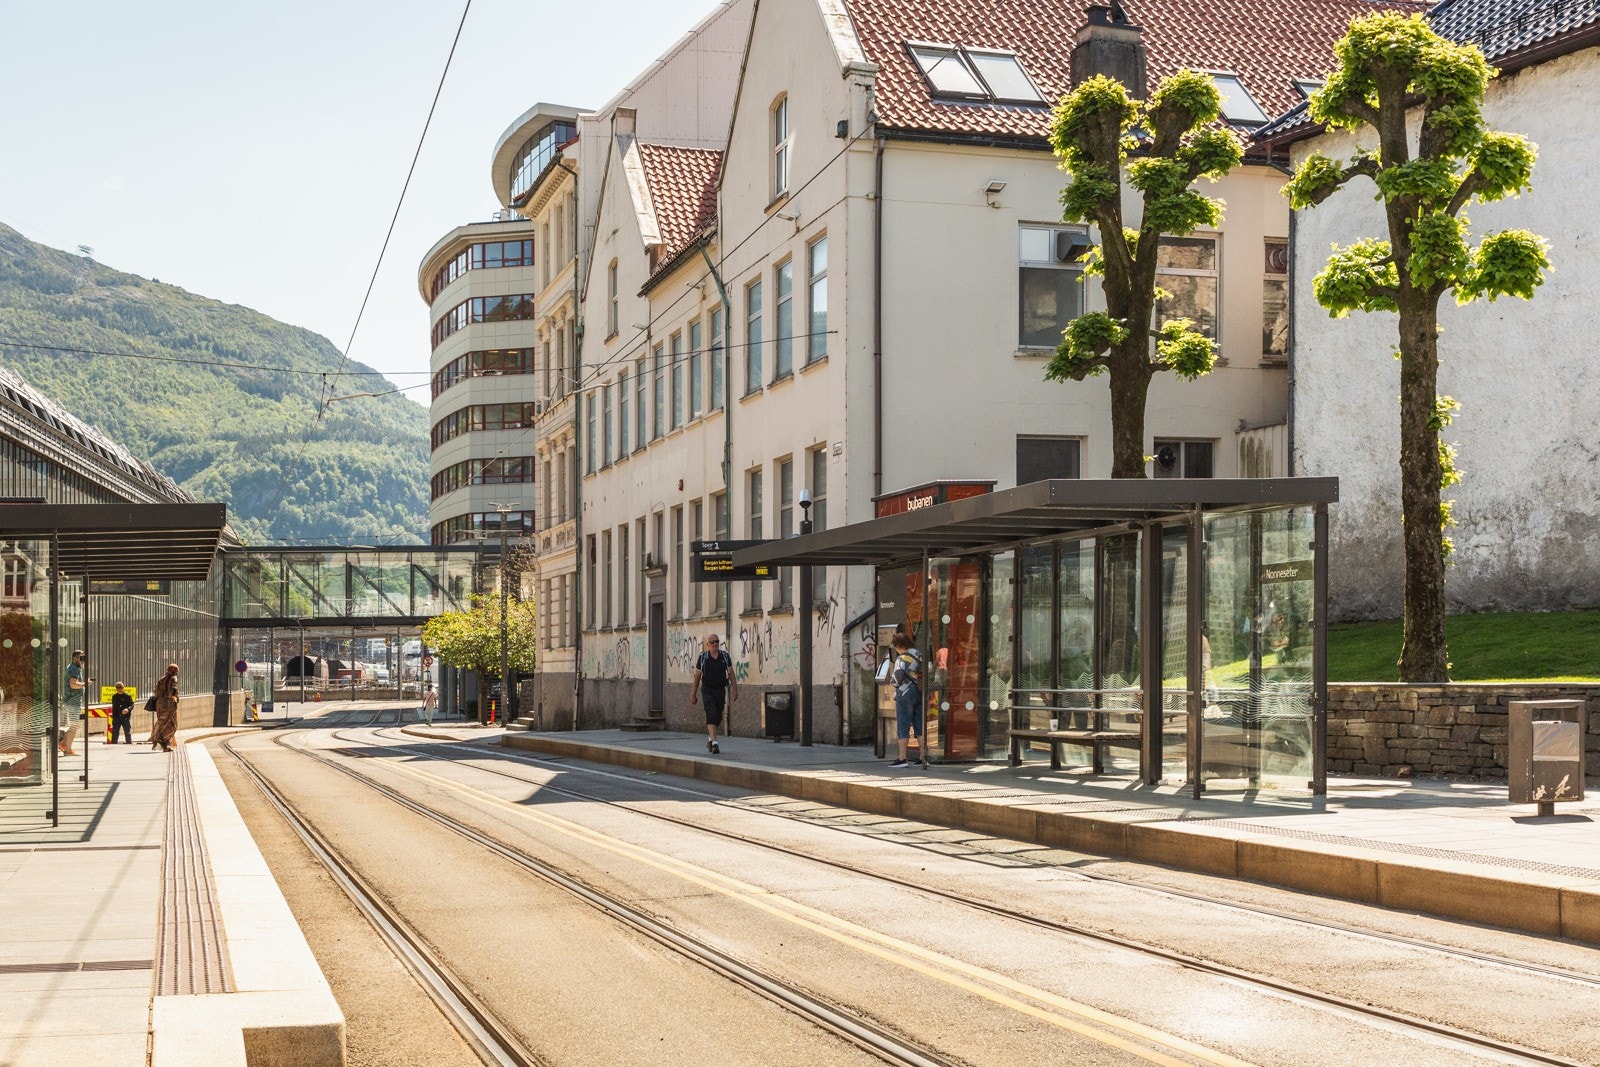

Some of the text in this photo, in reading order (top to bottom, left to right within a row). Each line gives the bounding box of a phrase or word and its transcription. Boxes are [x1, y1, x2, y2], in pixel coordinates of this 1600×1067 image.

[907, 496, 932, 510] bybanen
[714, 542, 720, 550] 1
[1266, 567, 1298, 579] Nonneseter
